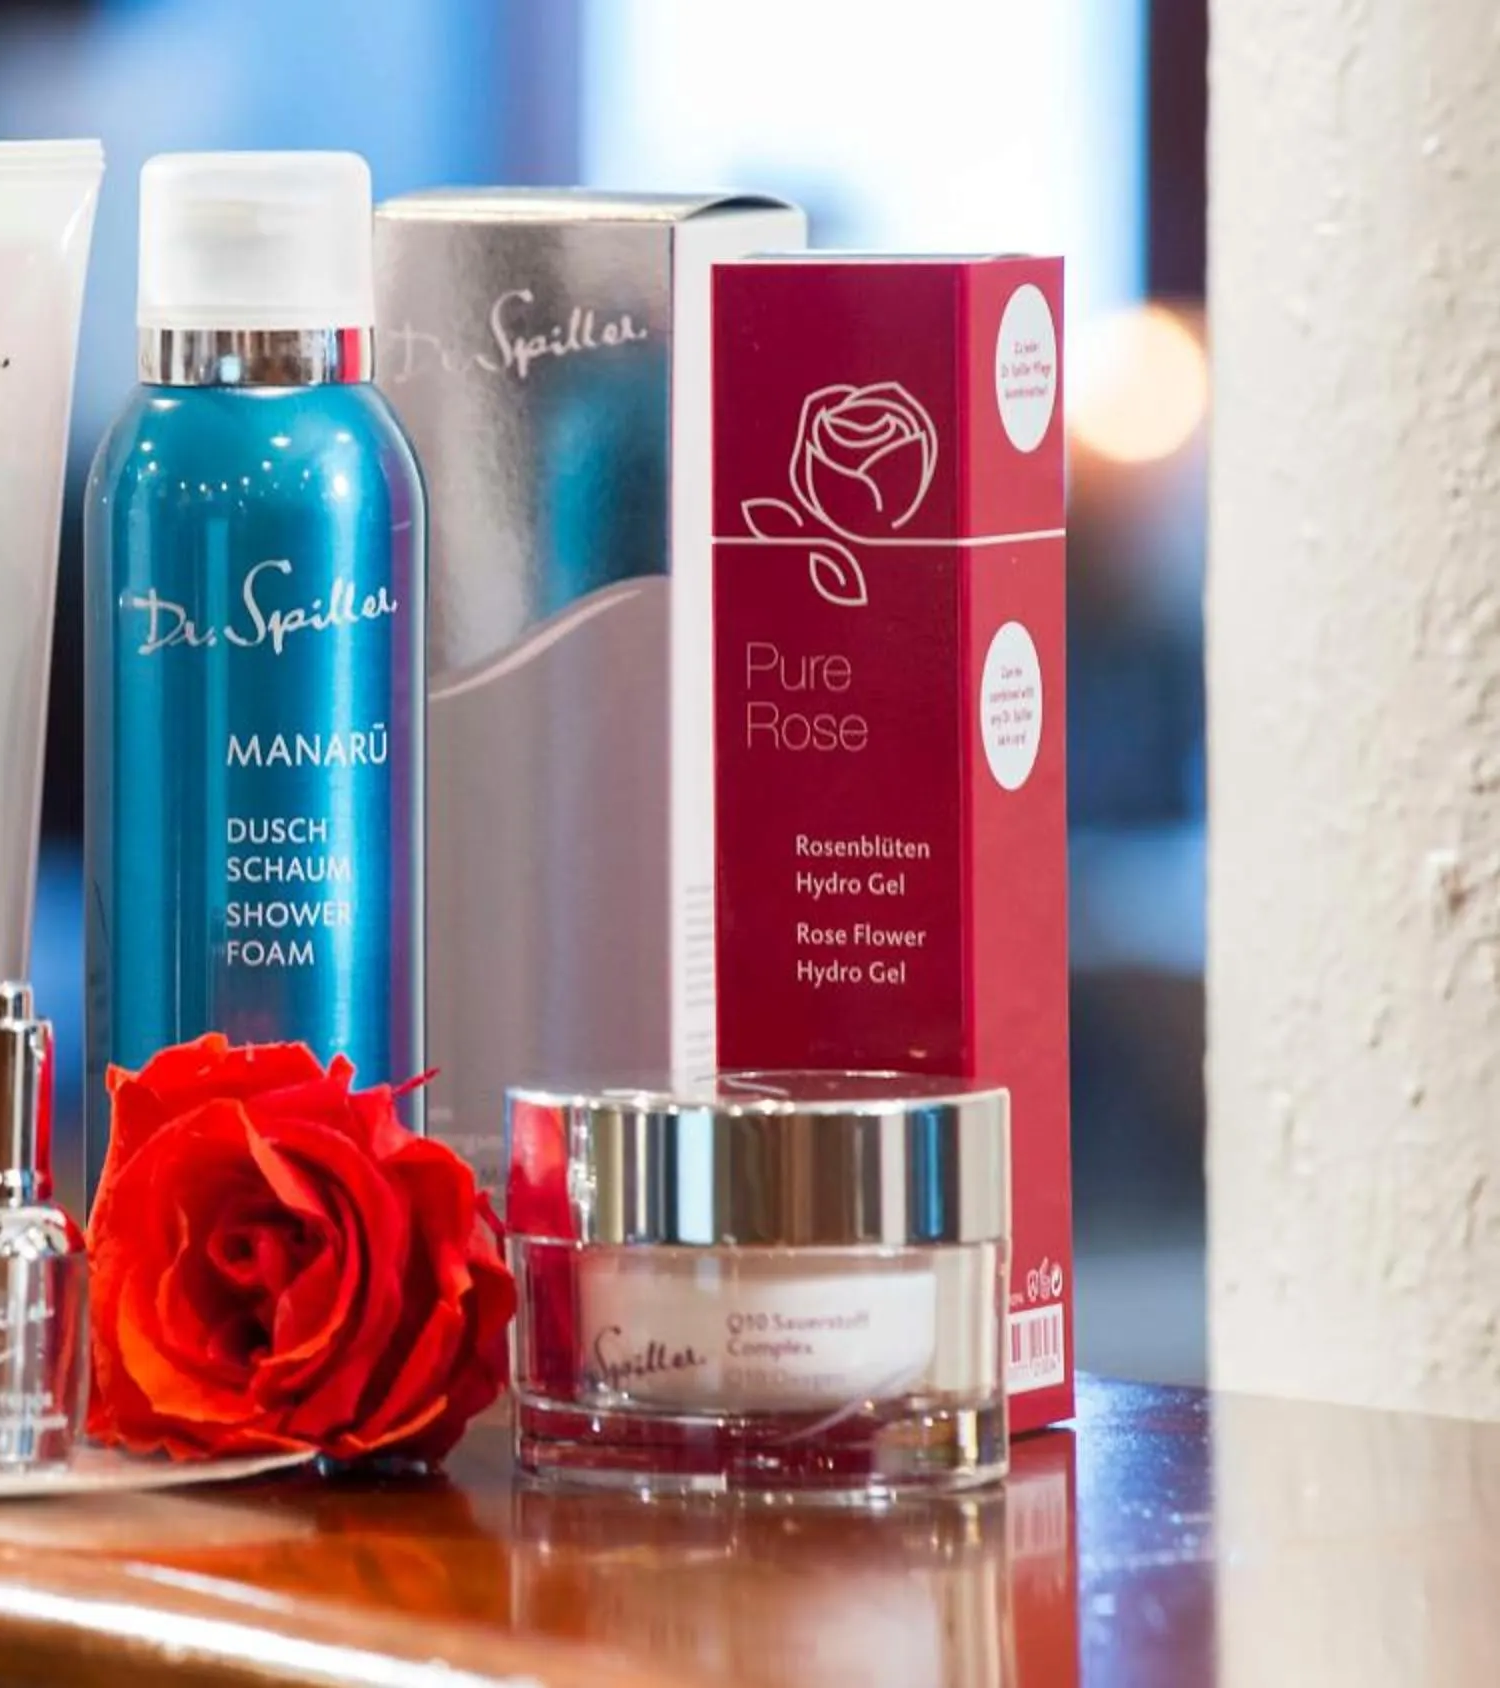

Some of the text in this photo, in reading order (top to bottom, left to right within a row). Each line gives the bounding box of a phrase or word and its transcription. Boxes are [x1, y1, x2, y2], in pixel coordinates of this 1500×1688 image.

[132, 559, 399, 656] Dr. Spiller
[746, 642, 851, 692] Pure
[746, 701, 868, 752] Rose
[226, 817, 328, 845] DUSCH
[795, 834, 931, 860] Rosenblüten
[226, 857, 352, 883] SCHAUM
[796, 871, 905, 901] Hydro Gel
[226, 901, 352, 929] SHOWER
[796, 922, 927, 948] Rose Flower
[226, 941, 315, 967] FOAM
[796, 959, 906, 989] Hydro Gel
[726, 1311, 769, 1335] Q10
